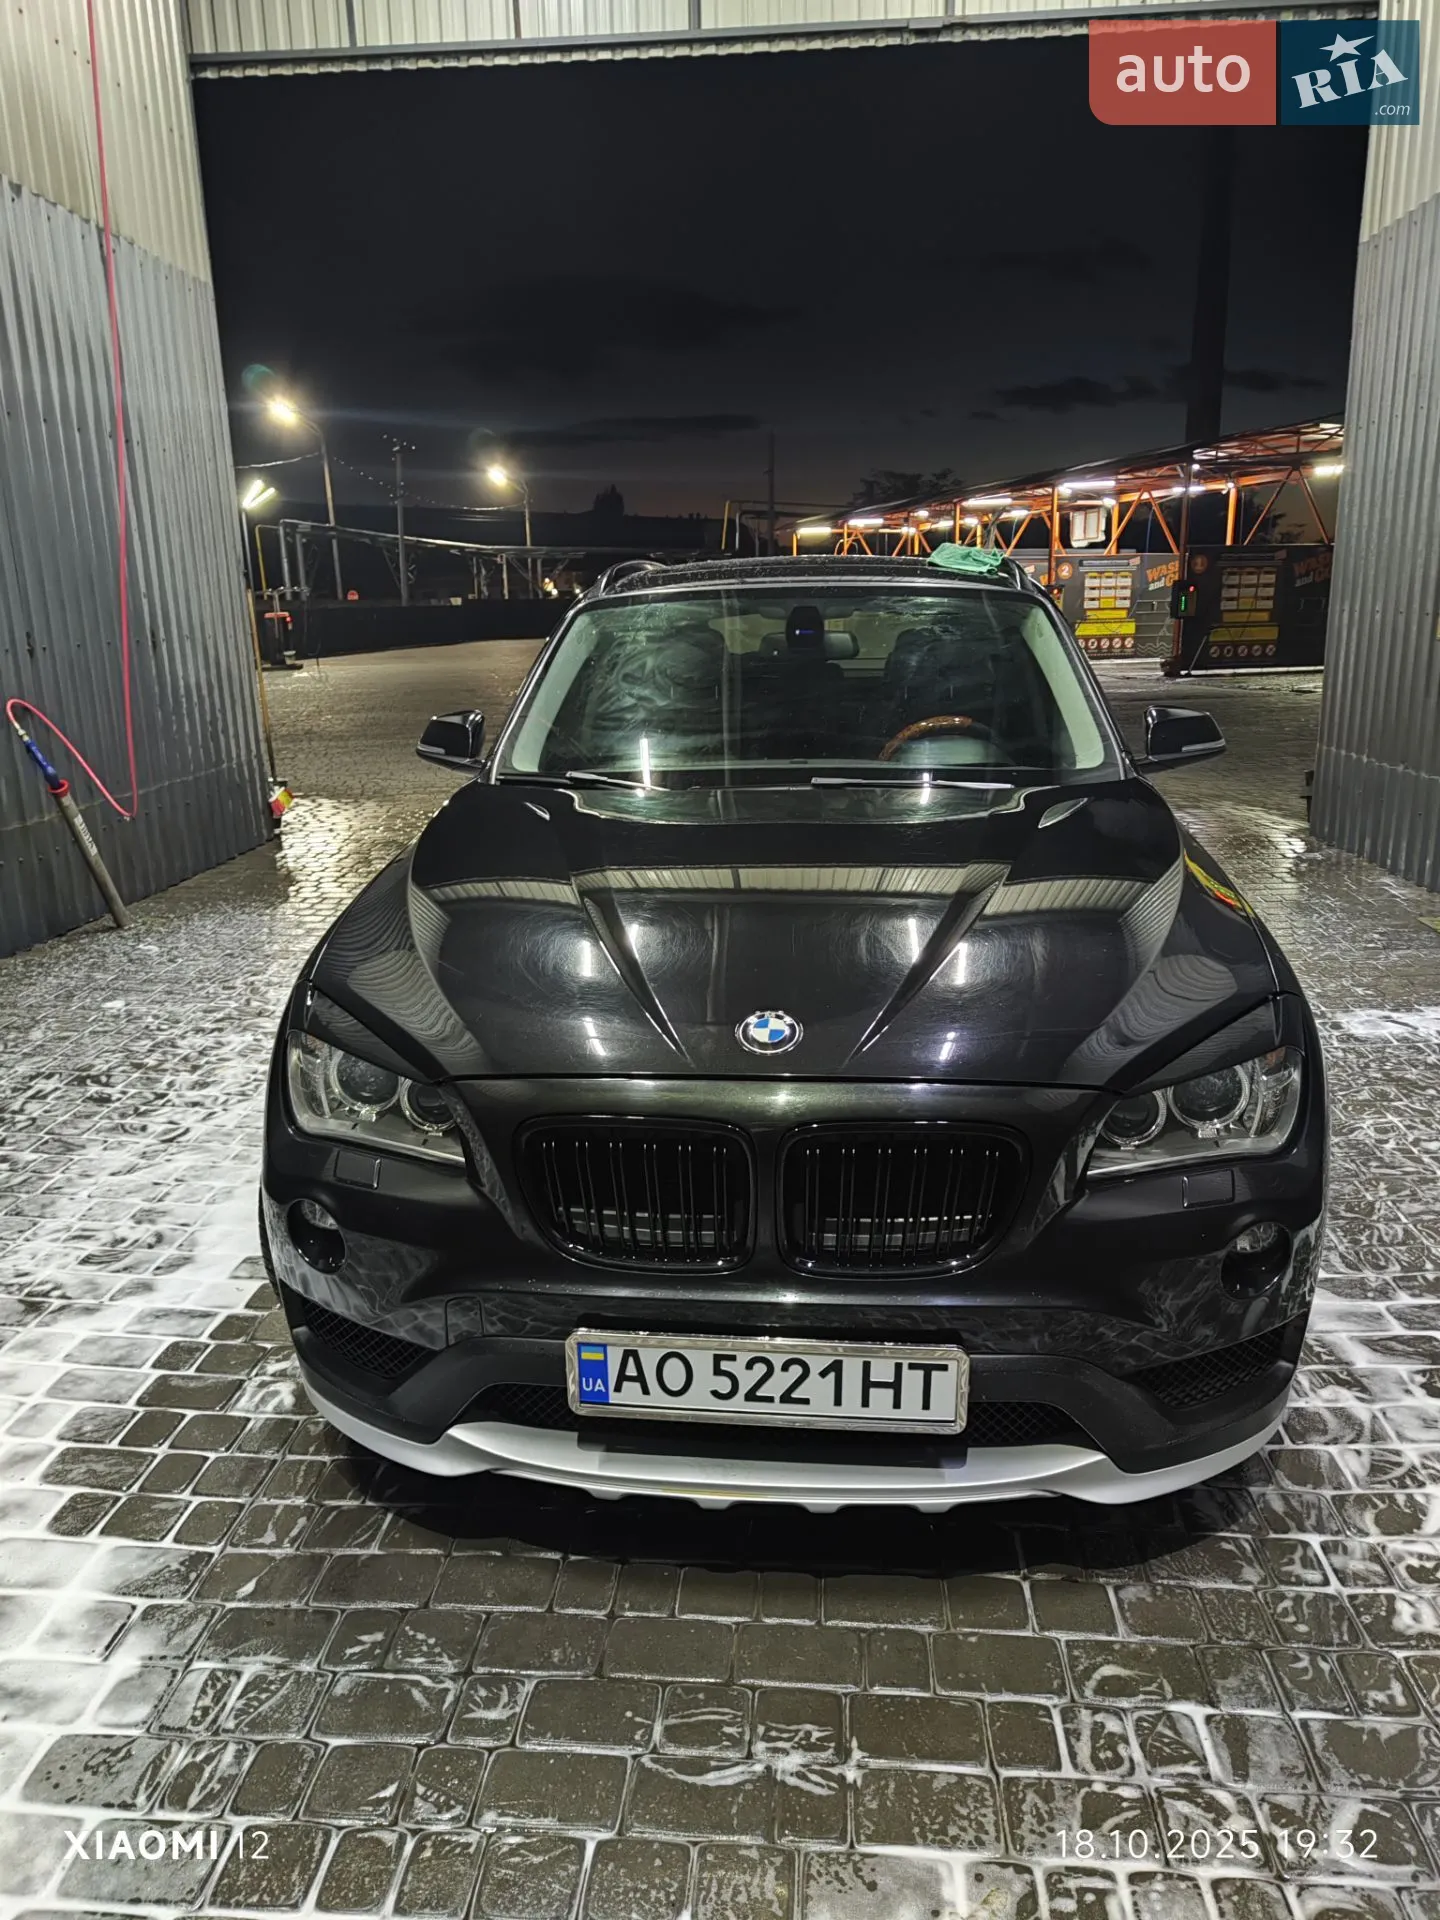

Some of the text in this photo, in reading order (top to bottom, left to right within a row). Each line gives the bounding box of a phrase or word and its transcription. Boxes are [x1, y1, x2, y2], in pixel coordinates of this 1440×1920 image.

[1062, 565, 1070, 576] 2
[1148, 576, 1165, 591] and
[582, 1377, 606, 1393] UA
[613, 1348, 949, 1411] AO 5221 HT
